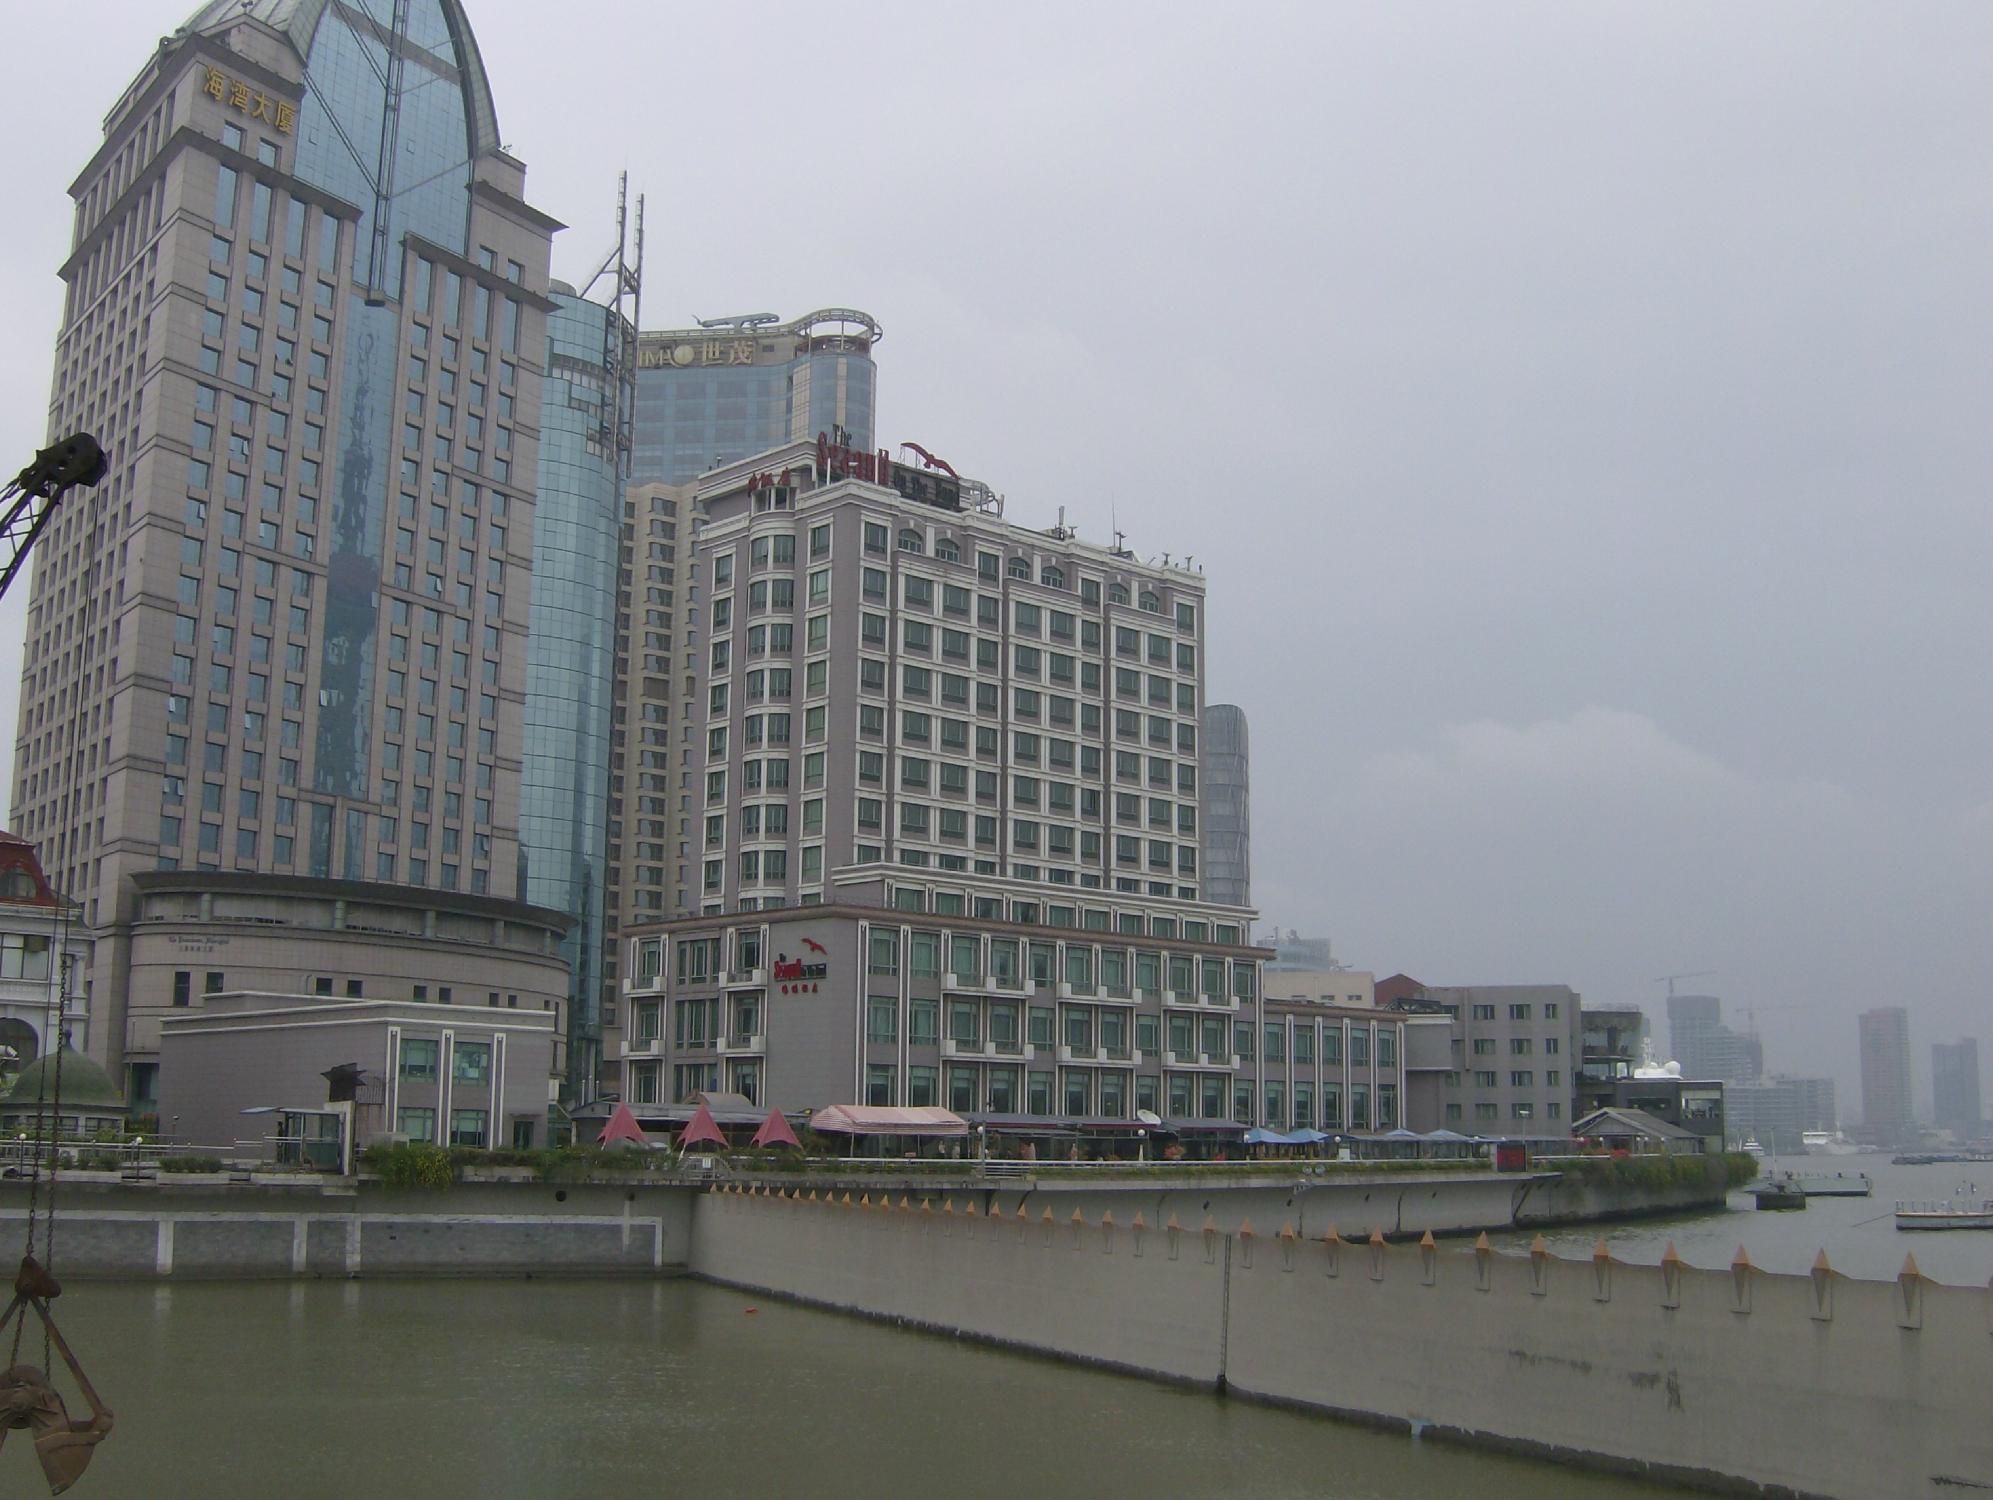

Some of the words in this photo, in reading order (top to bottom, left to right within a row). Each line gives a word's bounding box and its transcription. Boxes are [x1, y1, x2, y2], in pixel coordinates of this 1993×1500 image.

[203, 64, 296, 134] 海湾大厦
[702, 340, 752, 366] 世茂
[832, 423, 852, 447] The
